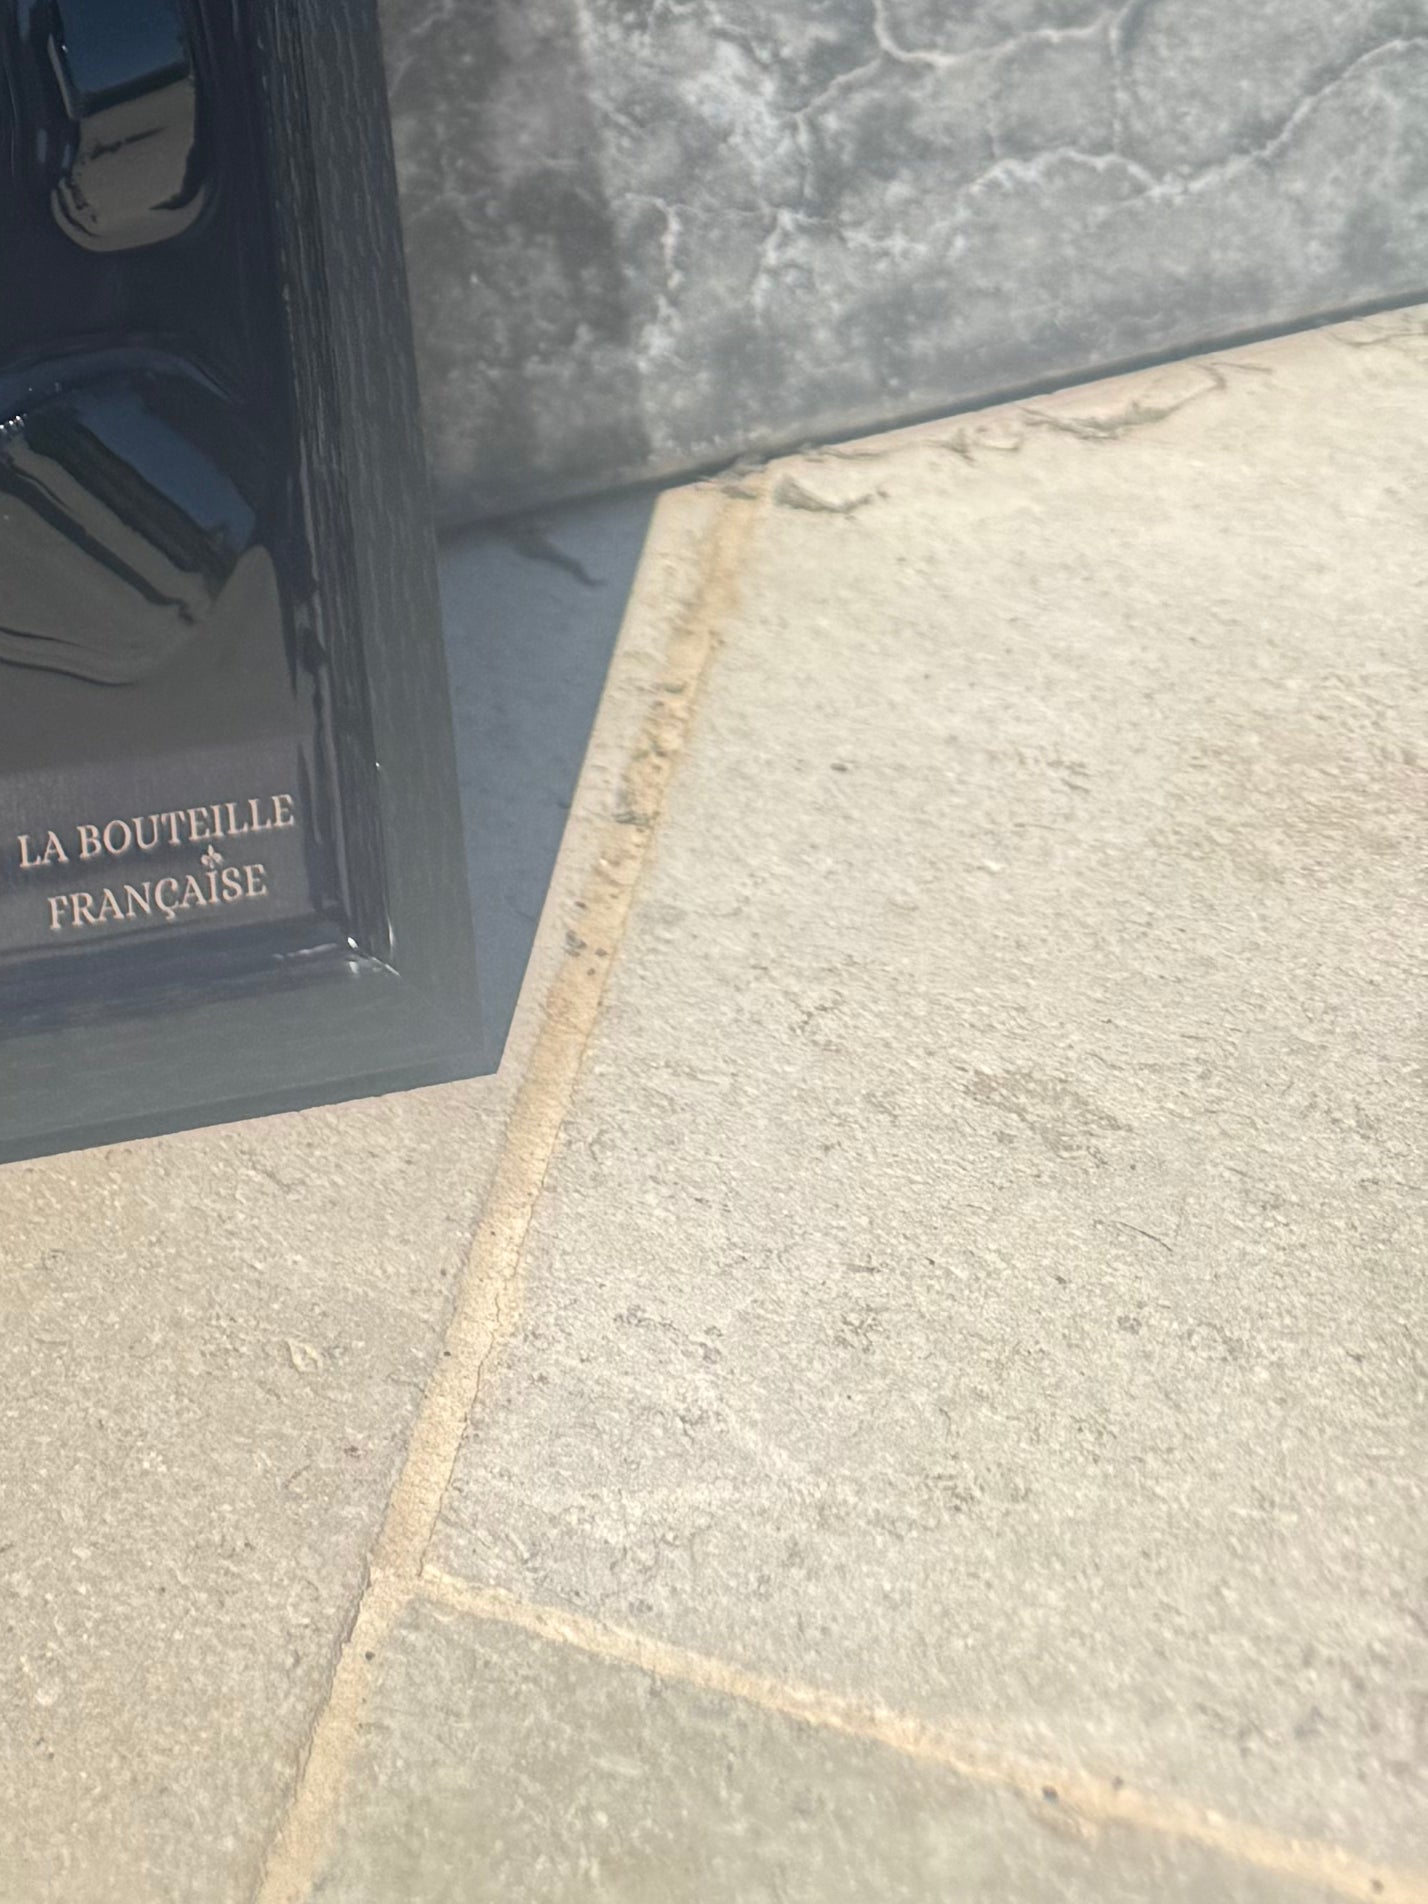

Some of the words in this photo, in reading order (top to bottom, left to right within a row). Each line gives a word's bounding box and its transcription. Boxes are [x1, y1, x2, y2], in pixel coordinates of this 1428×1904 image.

[16, 830, 70, 870] LA
[76, 793, 295, 860] BOUTEILLE
[47, 863, 268, 930] FRANÇAISE
